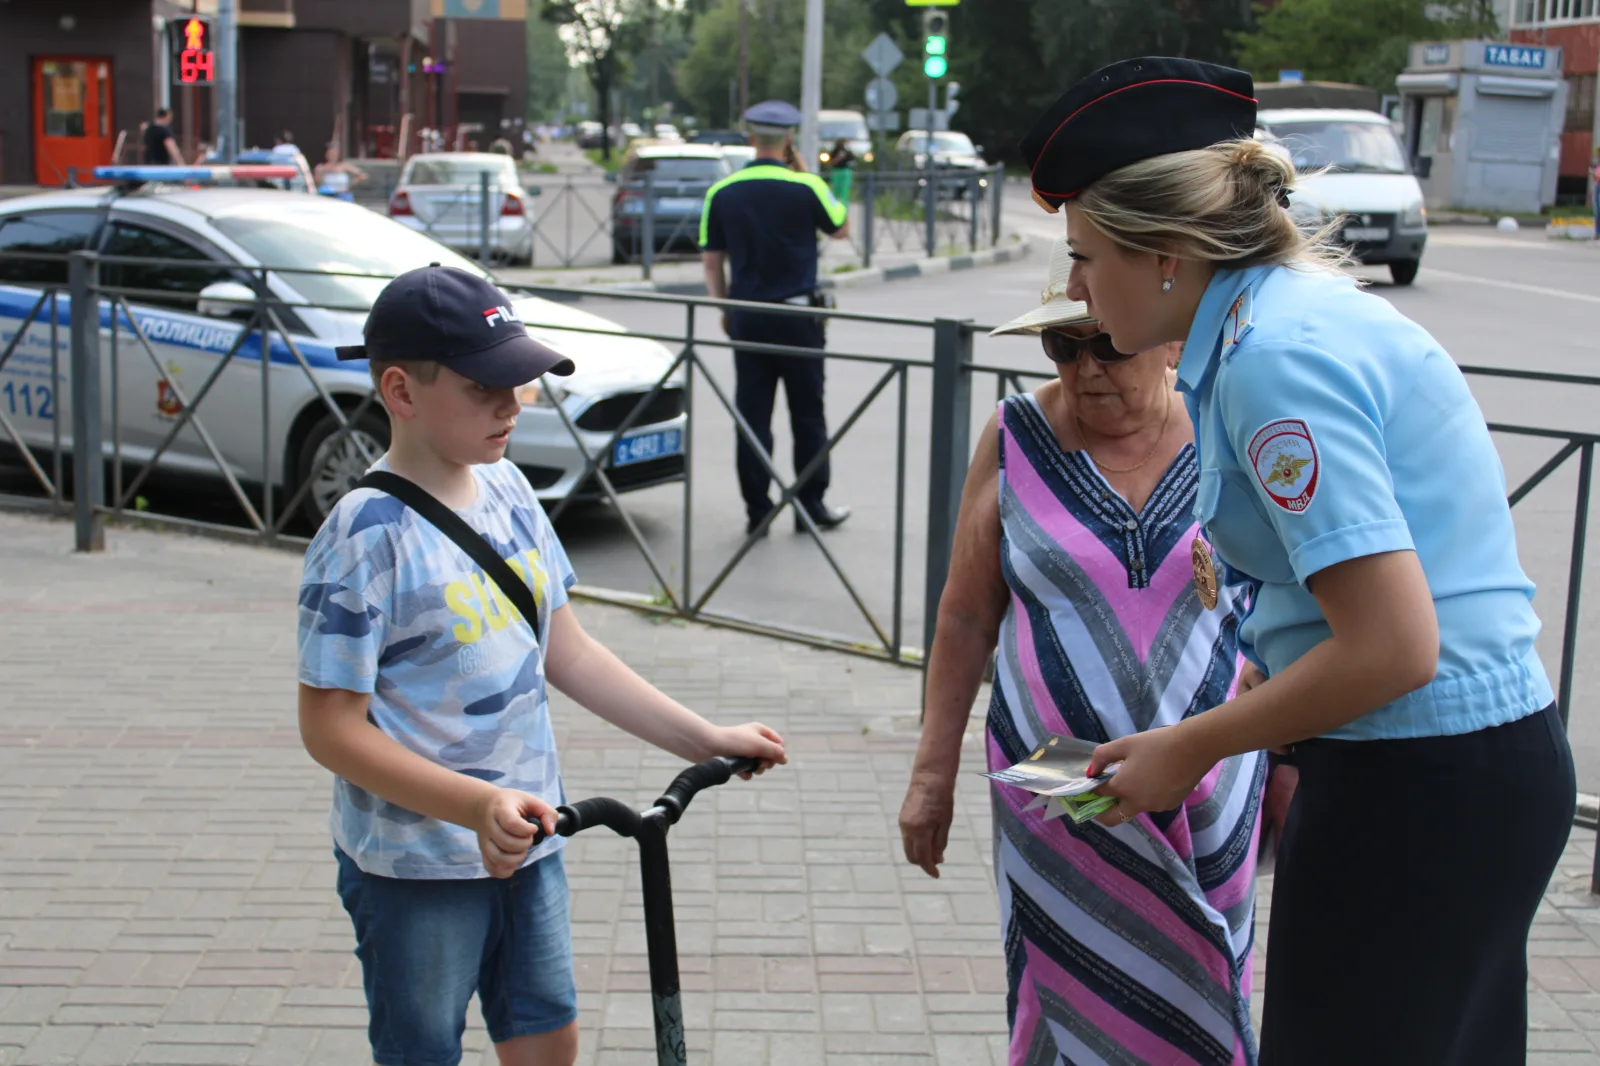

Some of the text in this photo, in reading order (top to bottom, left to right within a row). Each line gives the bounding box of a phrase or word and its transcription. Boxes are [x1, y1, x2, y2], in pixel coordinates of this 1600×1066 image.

[1487, 47, 1543, 67] ТАБАК
[140, 317, 238, 349] ПОЛИЦИЯ
[3, 380, 54, 419] 112
[1286, 491, 1310, 510] МВД
